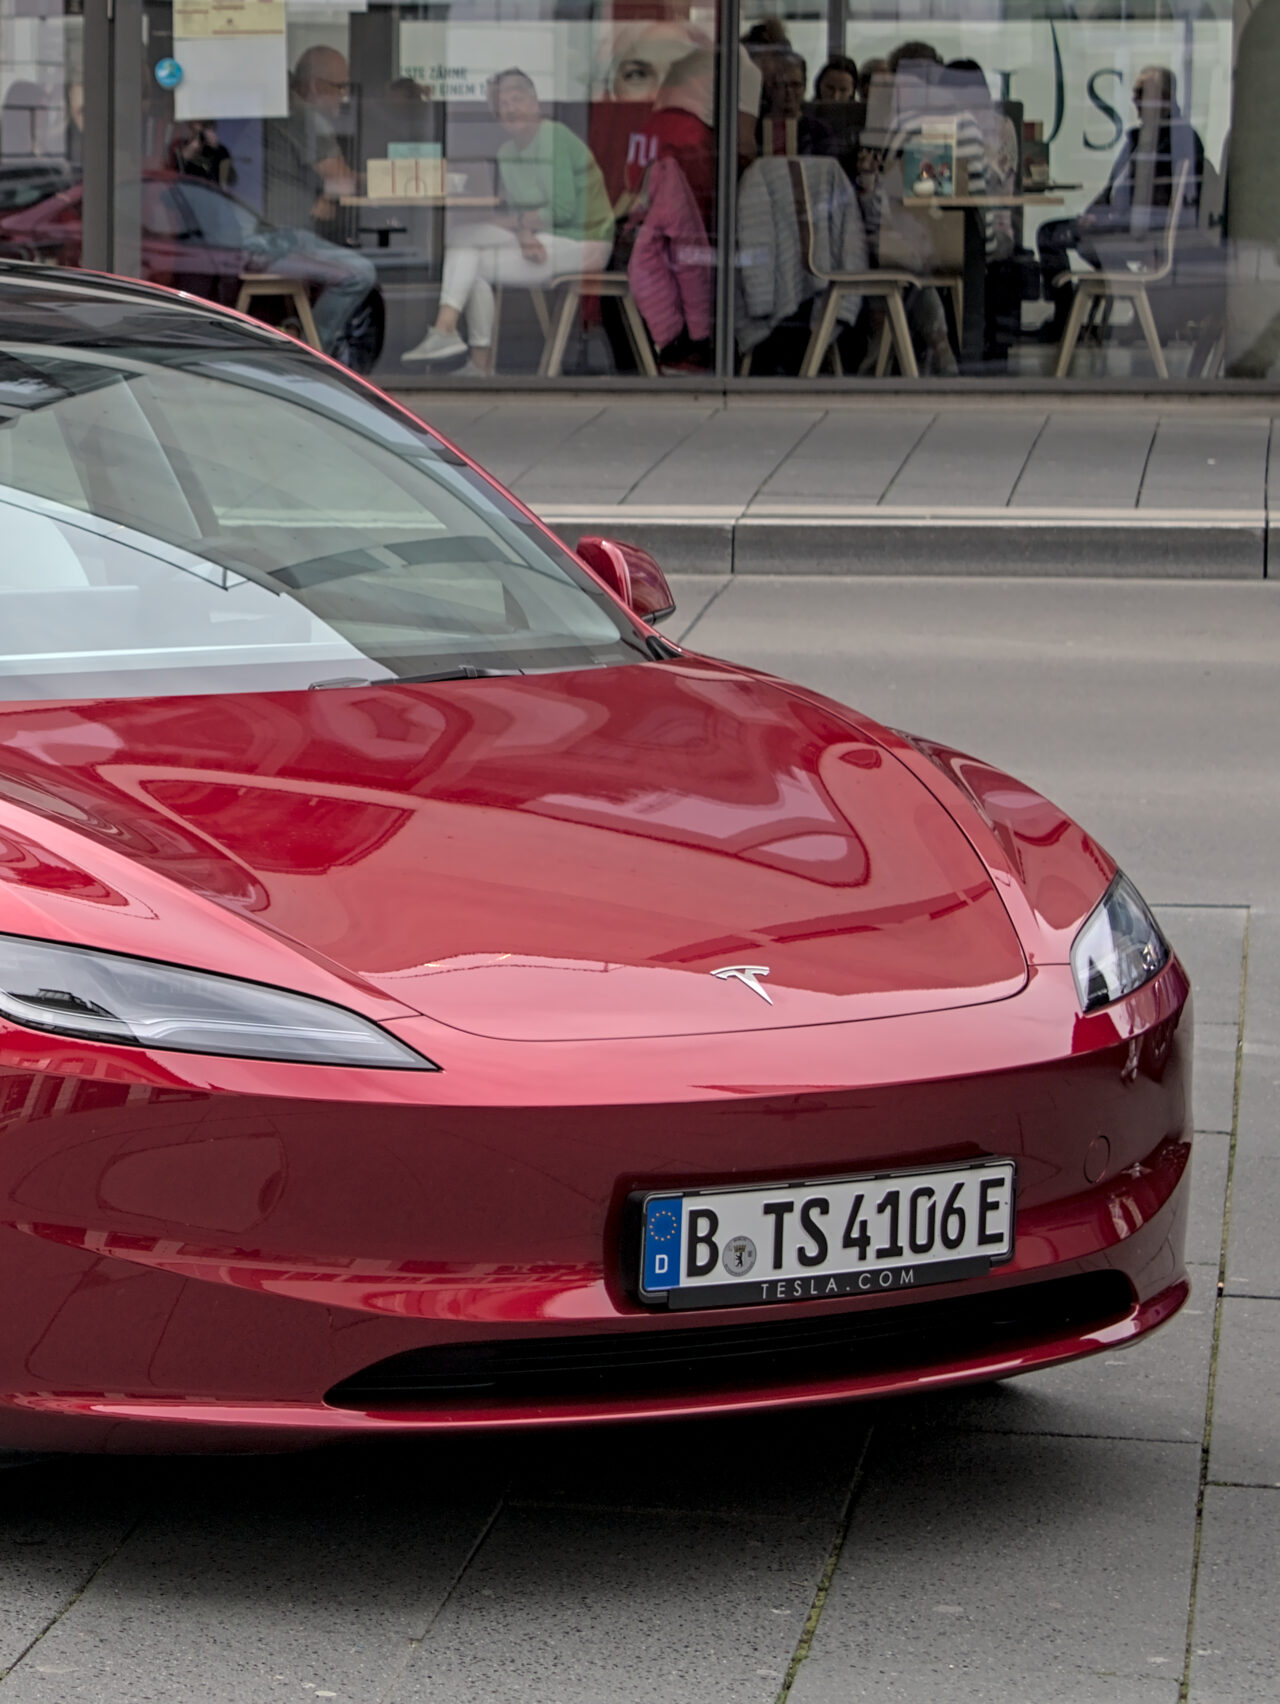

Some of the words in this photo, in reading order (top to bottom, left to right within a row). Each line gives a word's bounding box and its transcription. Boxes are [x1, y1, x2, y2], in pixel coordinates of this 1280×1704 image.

[685, 1207, 720, 1278] B
[654, 1253, 669, 1275] D
[760, 1268, 916, 1300] TESLA.COM
